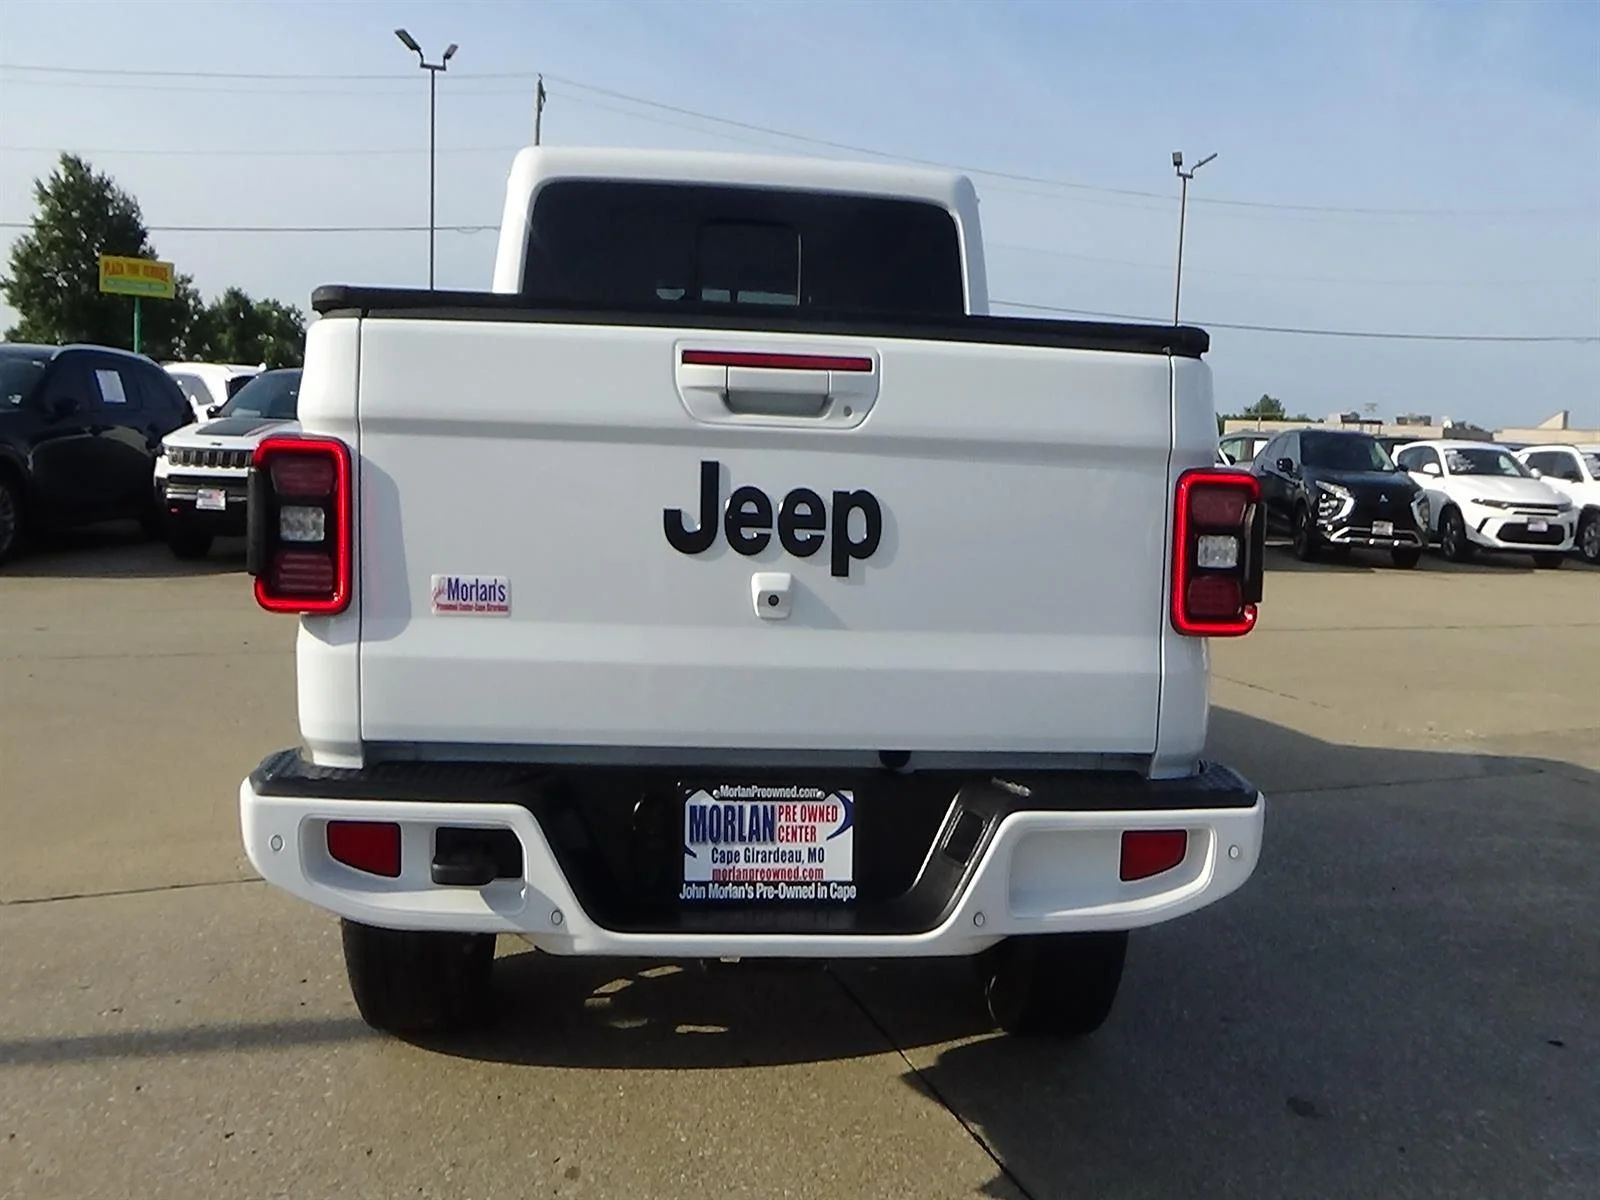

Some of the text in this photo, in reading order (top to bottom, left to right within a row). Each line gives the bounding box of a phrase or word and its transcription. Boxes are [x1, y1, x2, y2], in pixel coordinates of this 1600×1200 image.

[663, 461, 882, 577] Jeep
[447, 577, 506, 602] Morlan's
[720, 785, 818, 798] MorlanPreowned.com
[778, 804, 838, 823] PRE OWNED
[690, 805, 774, 843] MORLAN
[778, 825, 816, 843] CENTER
[711, 847, 825, 865] Cape Girardeau, MO
[712, 866, 824, 881] morlanpreowned.com
[679, 882, 857, 902] John Morlan's Pre-Owned in Cape
